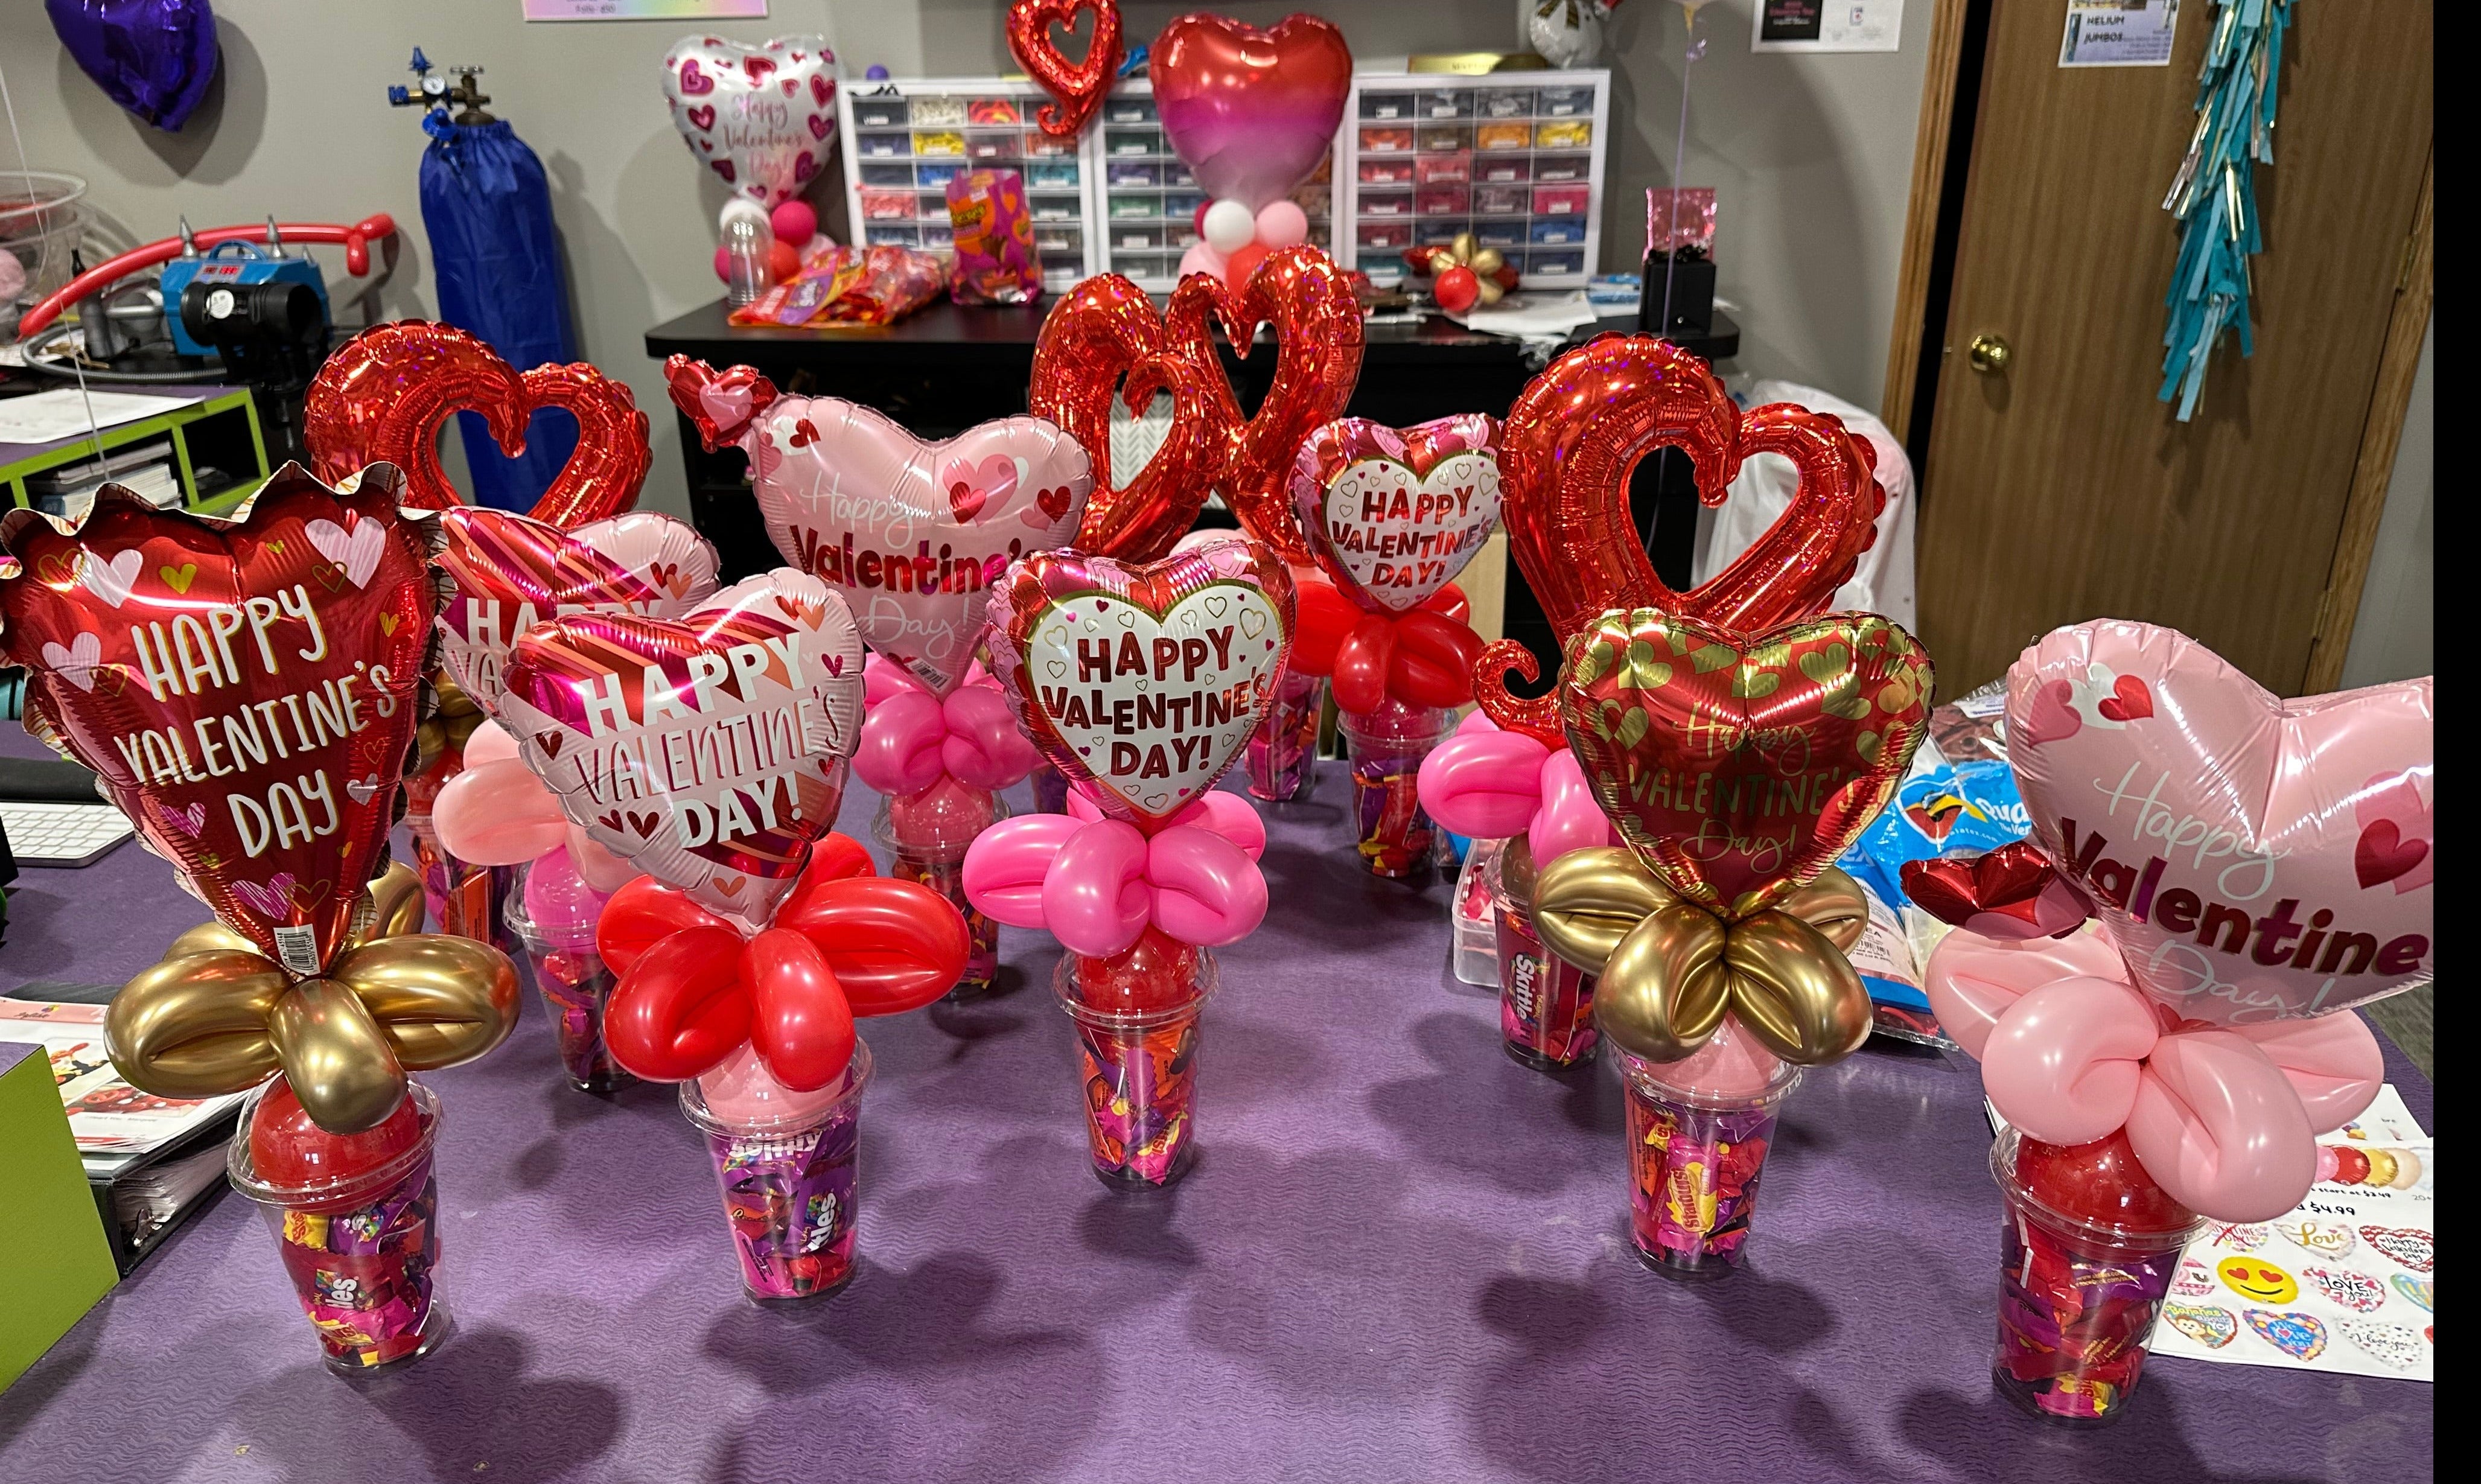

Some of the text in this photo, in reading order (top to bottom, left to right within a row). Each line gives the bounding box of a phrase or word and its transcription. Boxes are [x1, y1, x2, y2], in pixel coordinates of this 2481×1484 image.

[2083, 32, 2123, 44] JUMBOS
[2086, 15, 2124, 25] HELIUM
[731, 92, 788, 131] Happy
[800, 470, 914, 549] Happy
[1361, 485, 1474, 524] HAPPY
[789, 524, 1036, 595] Valentine'
[1332, 514, 1492, 559] VALENTINE'S
[1371, 561, 1445, 588] DAY!
[132, 584, 328, 702] HAPPY
[861, 594, 969, 660] Day!
[1077, 625, 1234, 683] HAPPY
[578, 632, 806, 739] HAPPY
[1041, 666, 1269, 735] VALENTINE'S
[113, 660, 398, 786] VALENTINE'S
[574, 685, 841, 804] VALENTINE'S
[1672, 701, 1819, 776] Happy
[1110, 735, 1212, 779] DAY!
[227, 769, 340, 859] DAY
[673, 772, 802, 849] DAY!
[1628, 763, 1862, 818] VALENTINE'S
[1679, 818, 1797, 873] Day!
[2093, 762, 2292, 900] Happy
[2126, 940, 2335, 1023] Day!
[2289, 1223, 2348, 1251] Love
[2310, 1200, 2355, 1216] $4.99
[2324, 1275, 2368, 1292] LOVE
